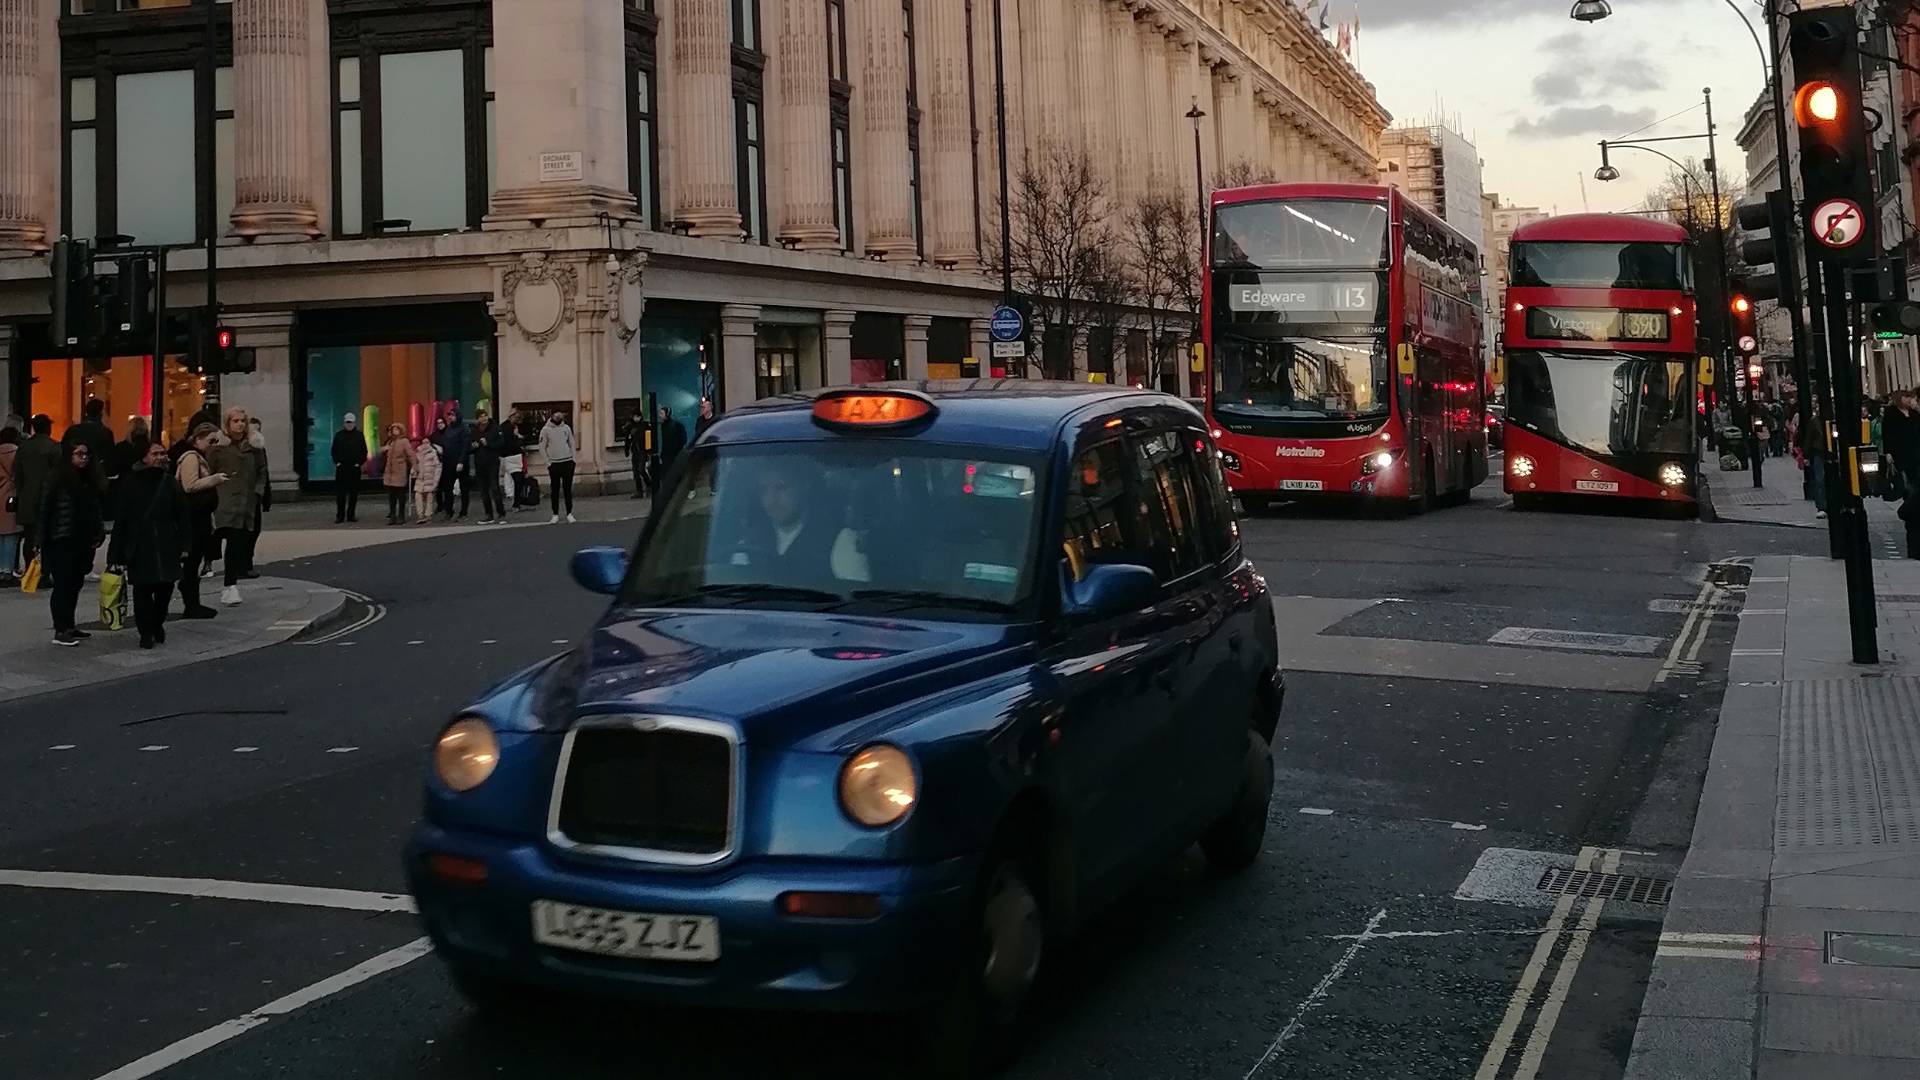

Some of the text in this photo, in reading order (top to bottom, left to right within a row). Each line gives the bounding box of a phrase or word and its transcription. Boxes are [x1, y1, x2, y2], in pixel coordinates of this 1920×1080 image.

[1242, 287, 1366, 308] Edgware 113
[1630, 314, 1661, 336] 390
[833, 398, 902, 419] TAXI
[1276, 446, 1326, 458] Metroline
[1304, 481, 1320, 489] AGX
[634, 917, 703, 950] ZJZ
